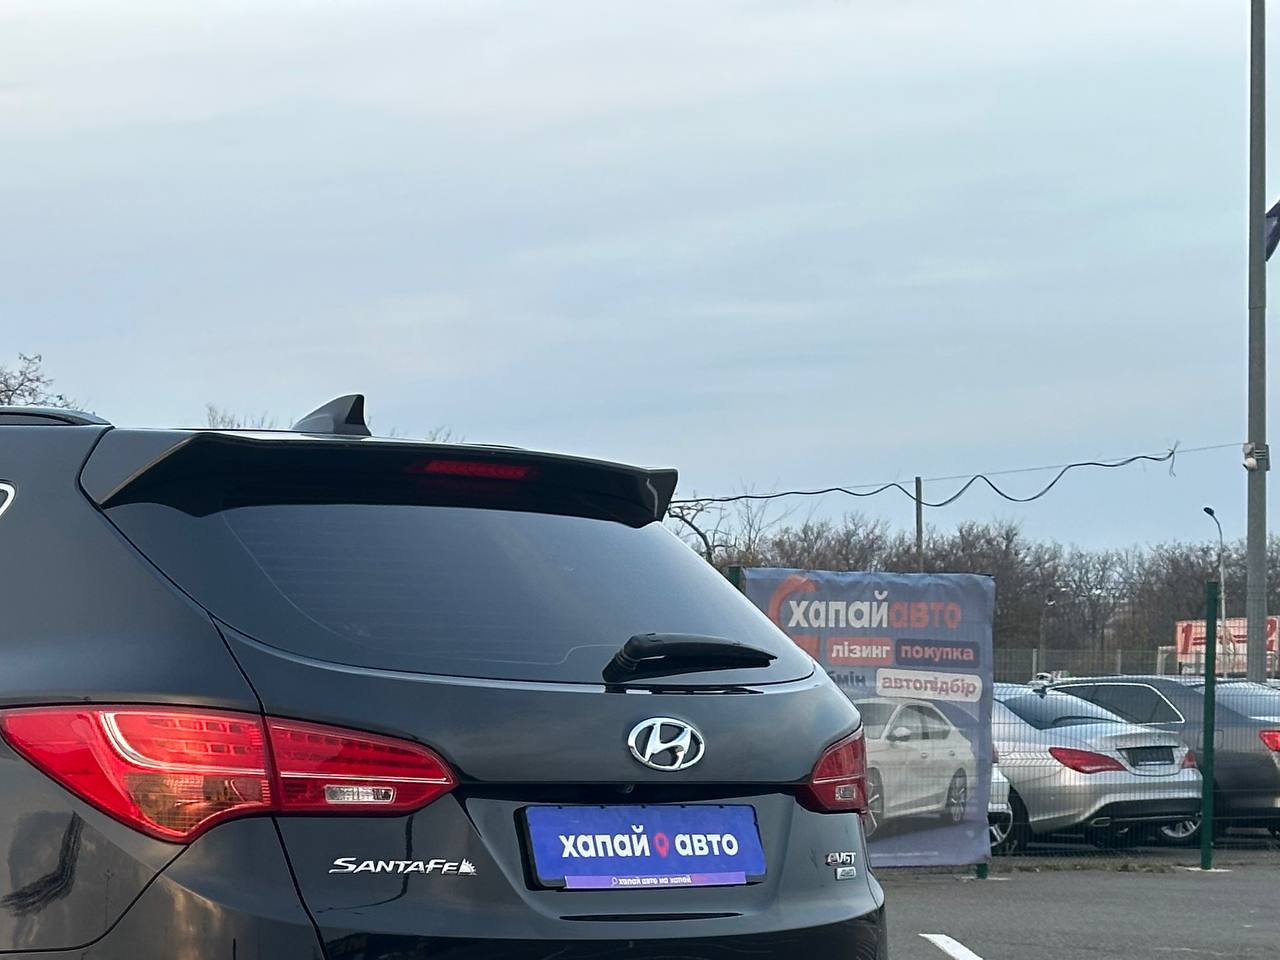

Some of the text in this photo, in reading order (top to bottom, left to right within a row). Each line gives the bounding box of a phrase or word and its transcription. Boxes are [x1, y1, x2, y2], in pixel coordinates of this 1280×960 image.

[832, 641, 974, 662] лізинг покупка
[882, 676, 977, 697] автопідбір
[559, 825, 739, 858] хапай авто
